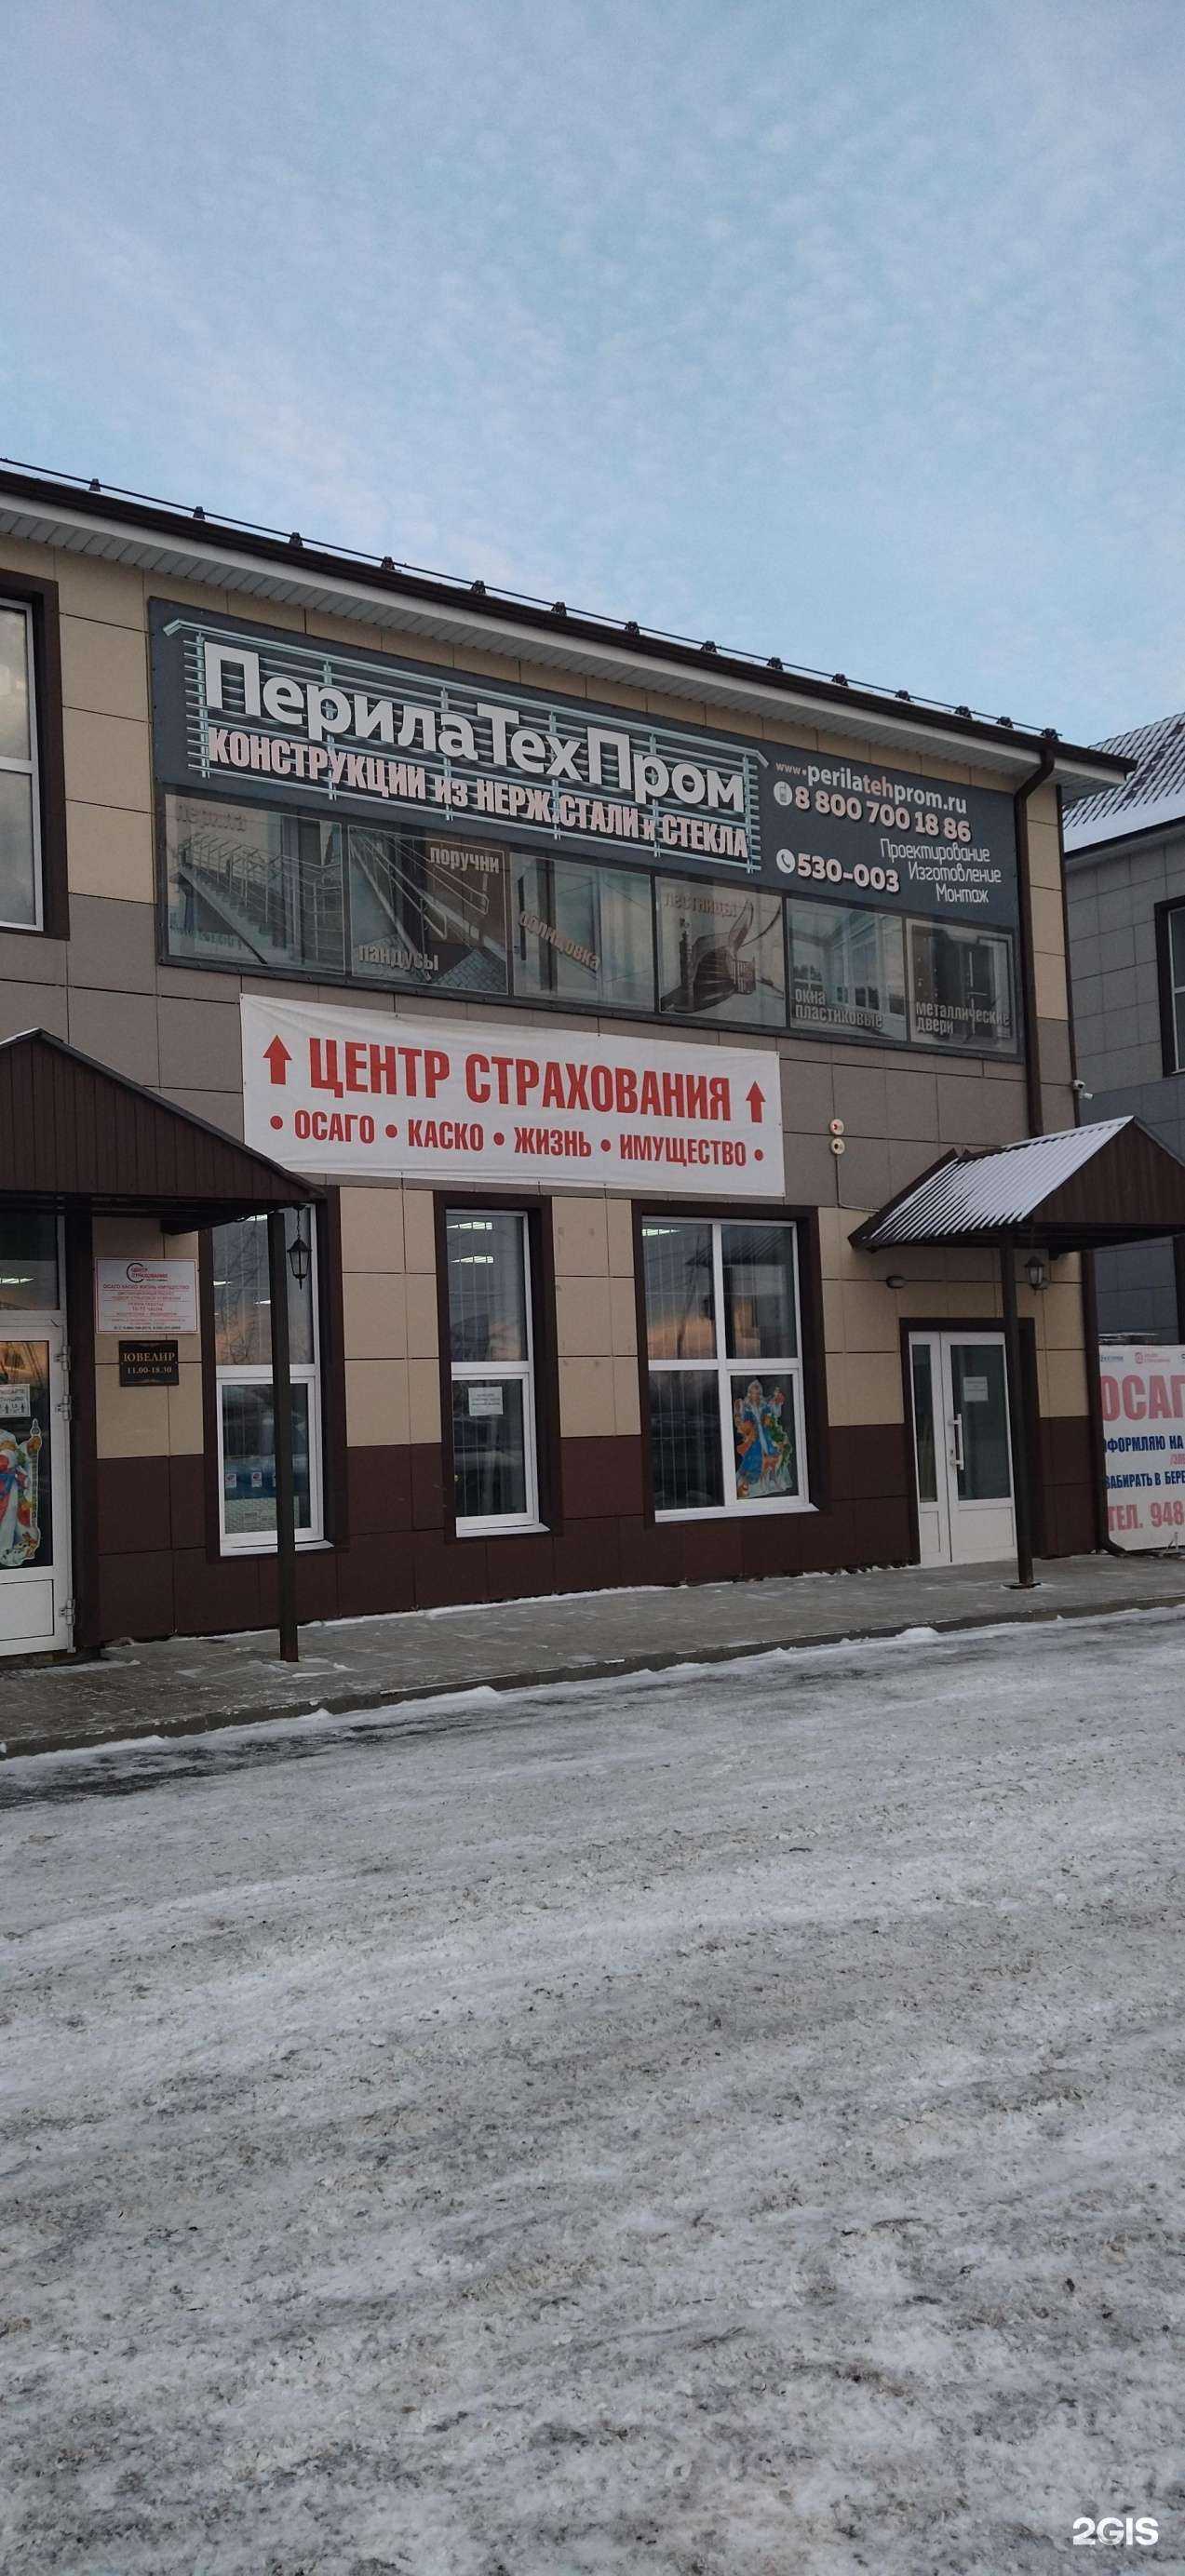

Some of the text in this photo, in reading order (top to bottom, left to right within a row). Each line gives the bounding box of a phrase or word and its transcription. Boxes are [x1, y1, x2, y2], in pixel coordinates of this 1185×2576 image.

[204, 641, 745, 813] ПерилаТехПром
[208, 727, 425, 799] КОНСТРУКЦИИ
[663, 814, 748, 858] СТЕКЛА
[795, 786, 971, 842] 8 800 700 18 86
[429, 848, 500, 874] поручни
[881, 838, 990, 863] Проектирование
[798, 852, 900, 893] 530-003
[909, 862, 1002, 883] Изготовление
[936, 883, 989, 904] Монтаж
[357, 945, 439, 972] пандусы
[795, 987, 826, 1005] окна
[795, 1004, 883, 1028] пластиковые
[916, 1000, 1010, 1026] металлические
[917, 1016, 954, 1035] двери
[309, 1038, 731, 1120] ЦЕНТР СТРАХОВАНИЯ
[294, 1109, 746, 1167] ОСАГО КАСКО ЖИЗНЬ ИМУЩЕСТВО
[123, 1351, 175, 1362] ЮВЕЛИР
[1169, 1435, 1184, 1449] НА
[1155, 1472, 1161, 1486] В
